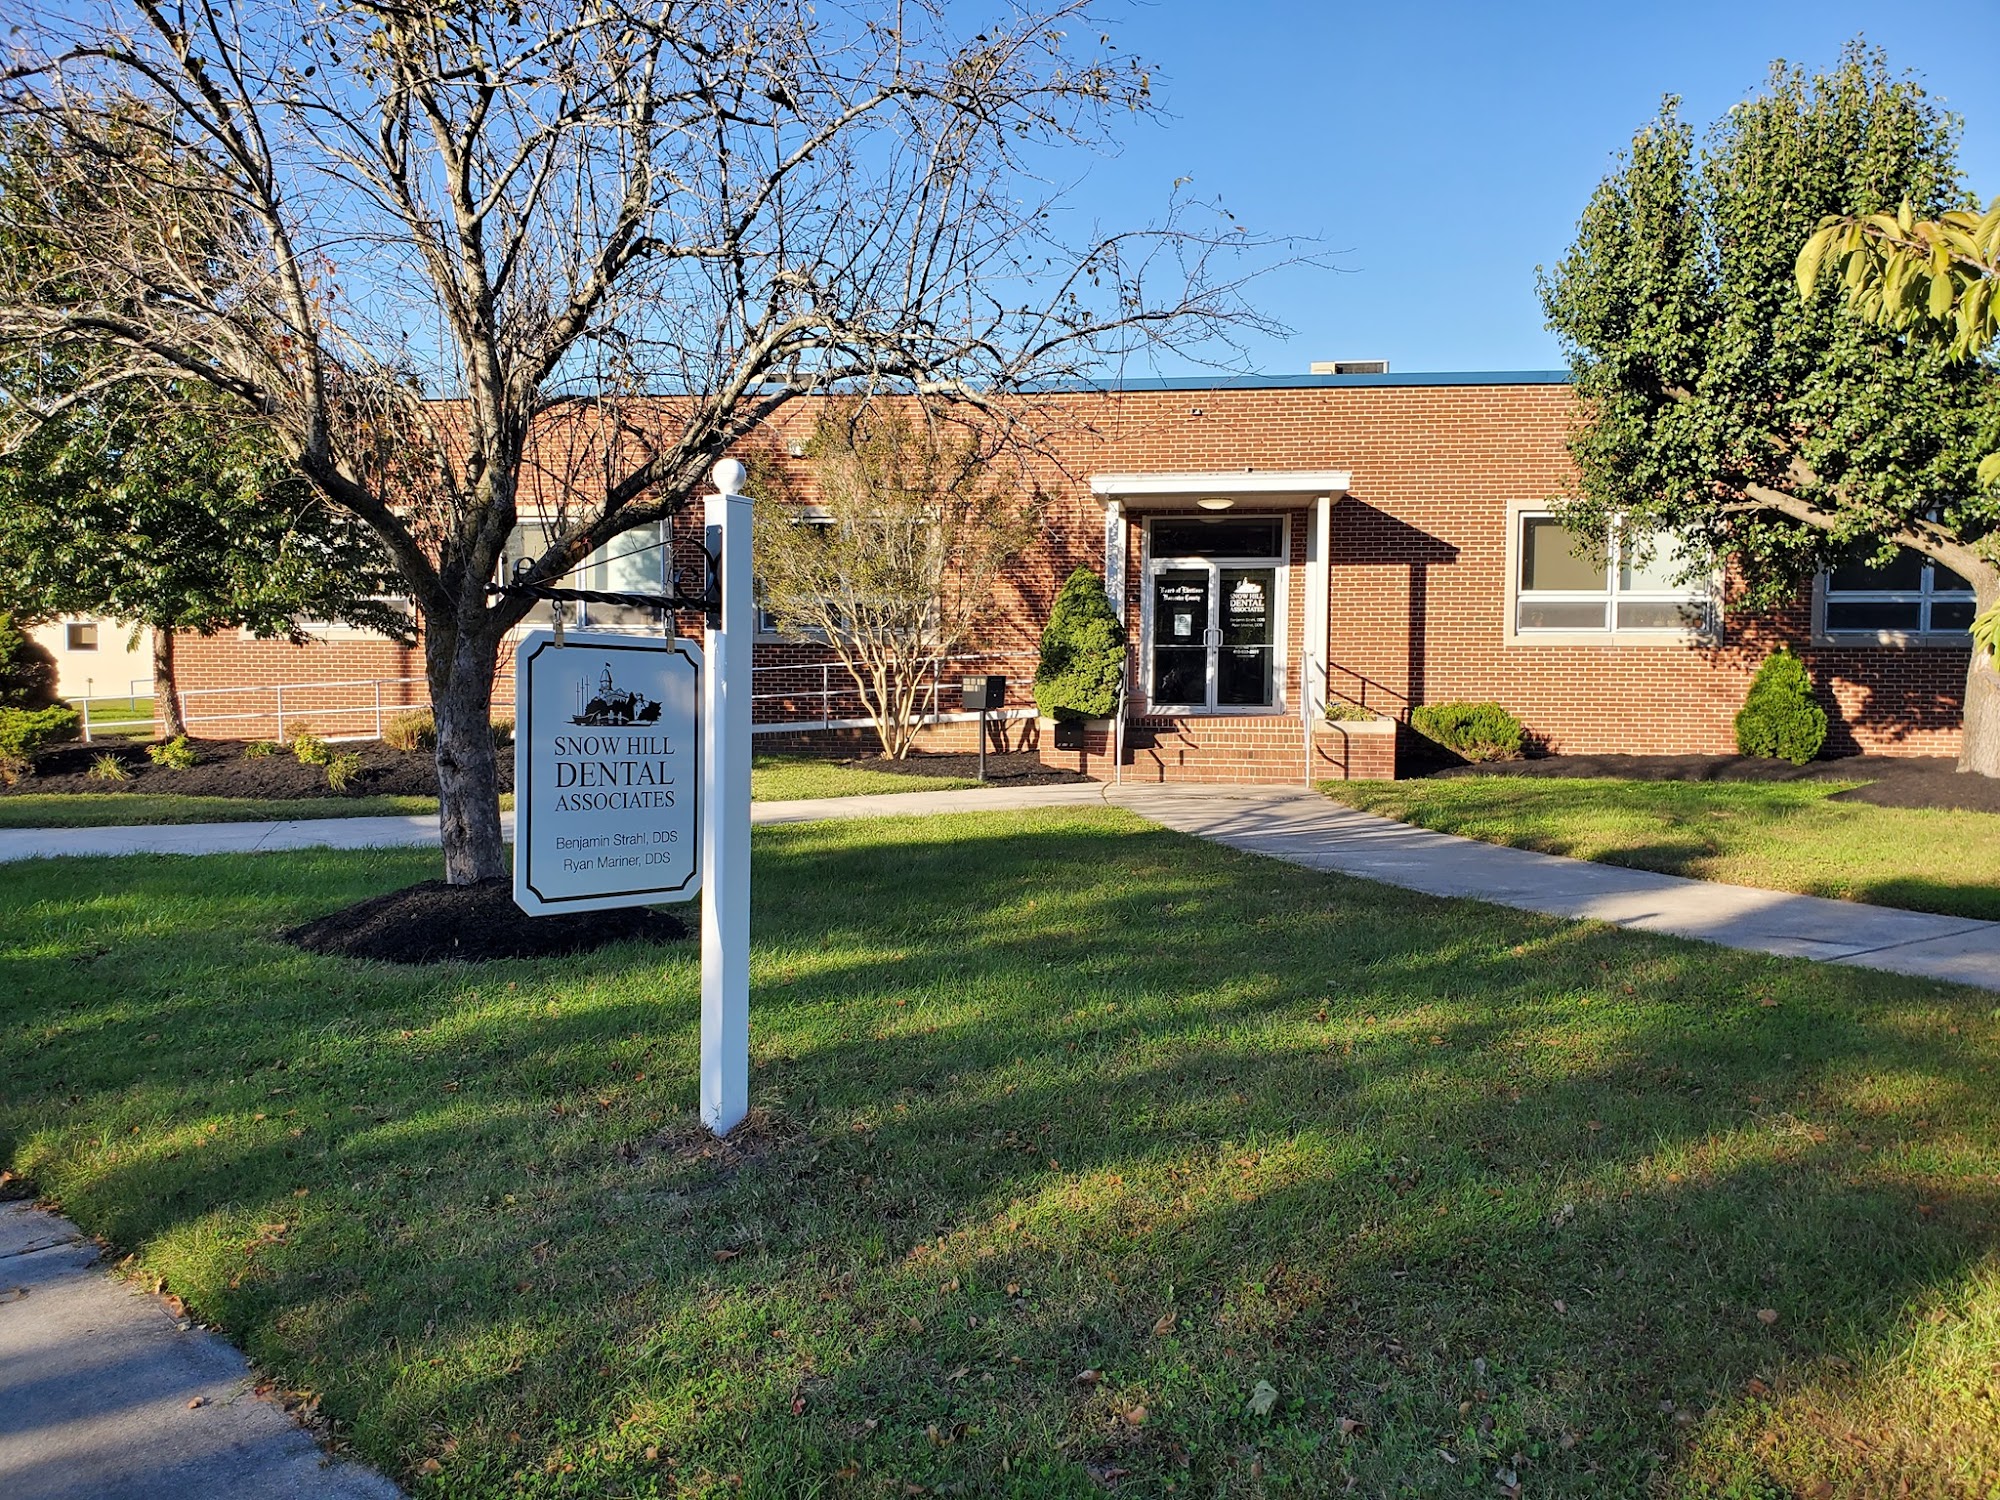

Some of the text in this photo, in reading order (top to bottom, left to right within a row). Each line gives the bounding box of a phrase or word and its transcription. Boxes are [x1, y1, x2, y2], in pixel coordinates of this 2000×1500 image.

[1230, 599, 1265, 607] DENTAL
[555, 736, 675, 756] SNOW HILL
[555, 761, 675, 788] DENTAL
[555, 791, 675, 812] ASSOCIATES
[556, 830, 678, 852] Benjamin Strahl, DDS
[563, 851, 671, 874] Ryan Mariner, DDS
